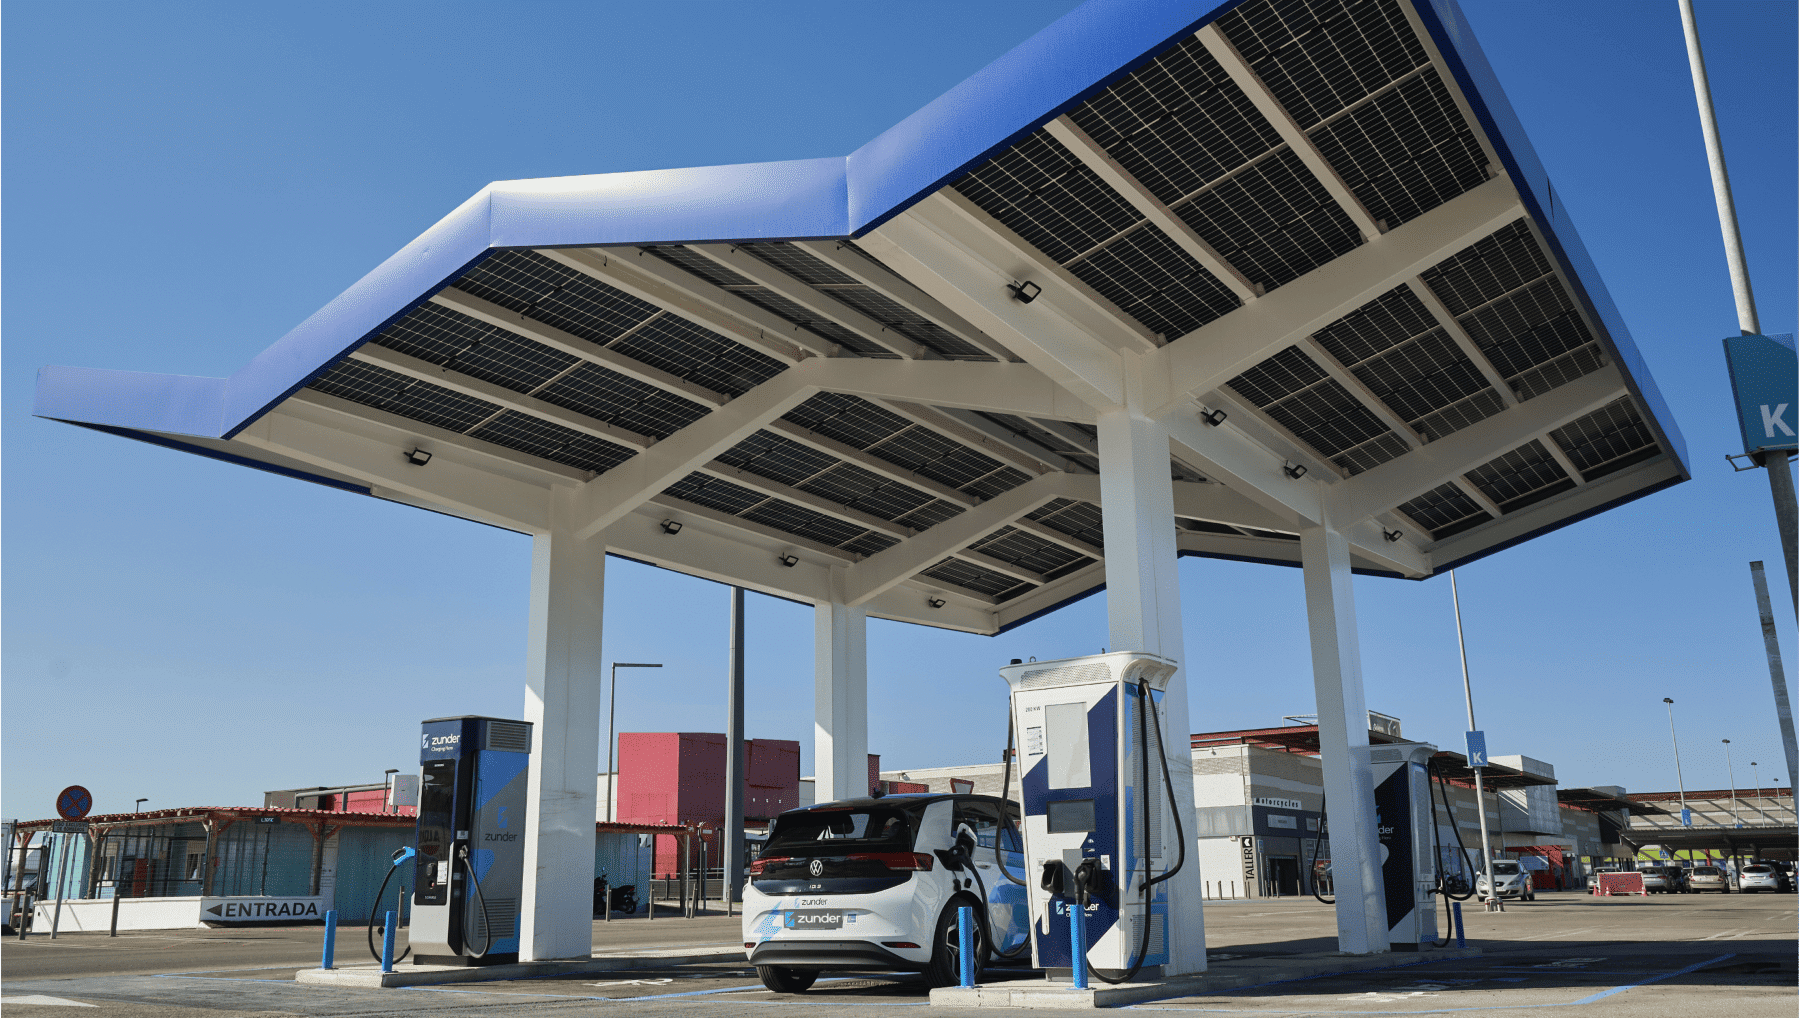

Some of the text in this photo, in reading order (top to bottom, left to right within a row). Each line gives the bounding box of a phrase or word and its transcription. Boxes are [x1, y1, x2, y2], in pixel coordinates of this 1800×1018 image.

[1759, 403, 1796, 438] K
[431, 733, 460, 745] zunder
[1473, 752, 1484, 763] K
[1255, 797, 1299, 807] Motorcycles
[1378, 824, 1394, 835] der
[485, 831, 518, 842] zunder
[1243, 848, 1255, 880] TALLER
[801, 897, 828, 906] zunder
[1065, 903, 1100, 911] zer
[225, 902, 318, 917] ENTRADA
[797, 912, 841, 924] zunder
